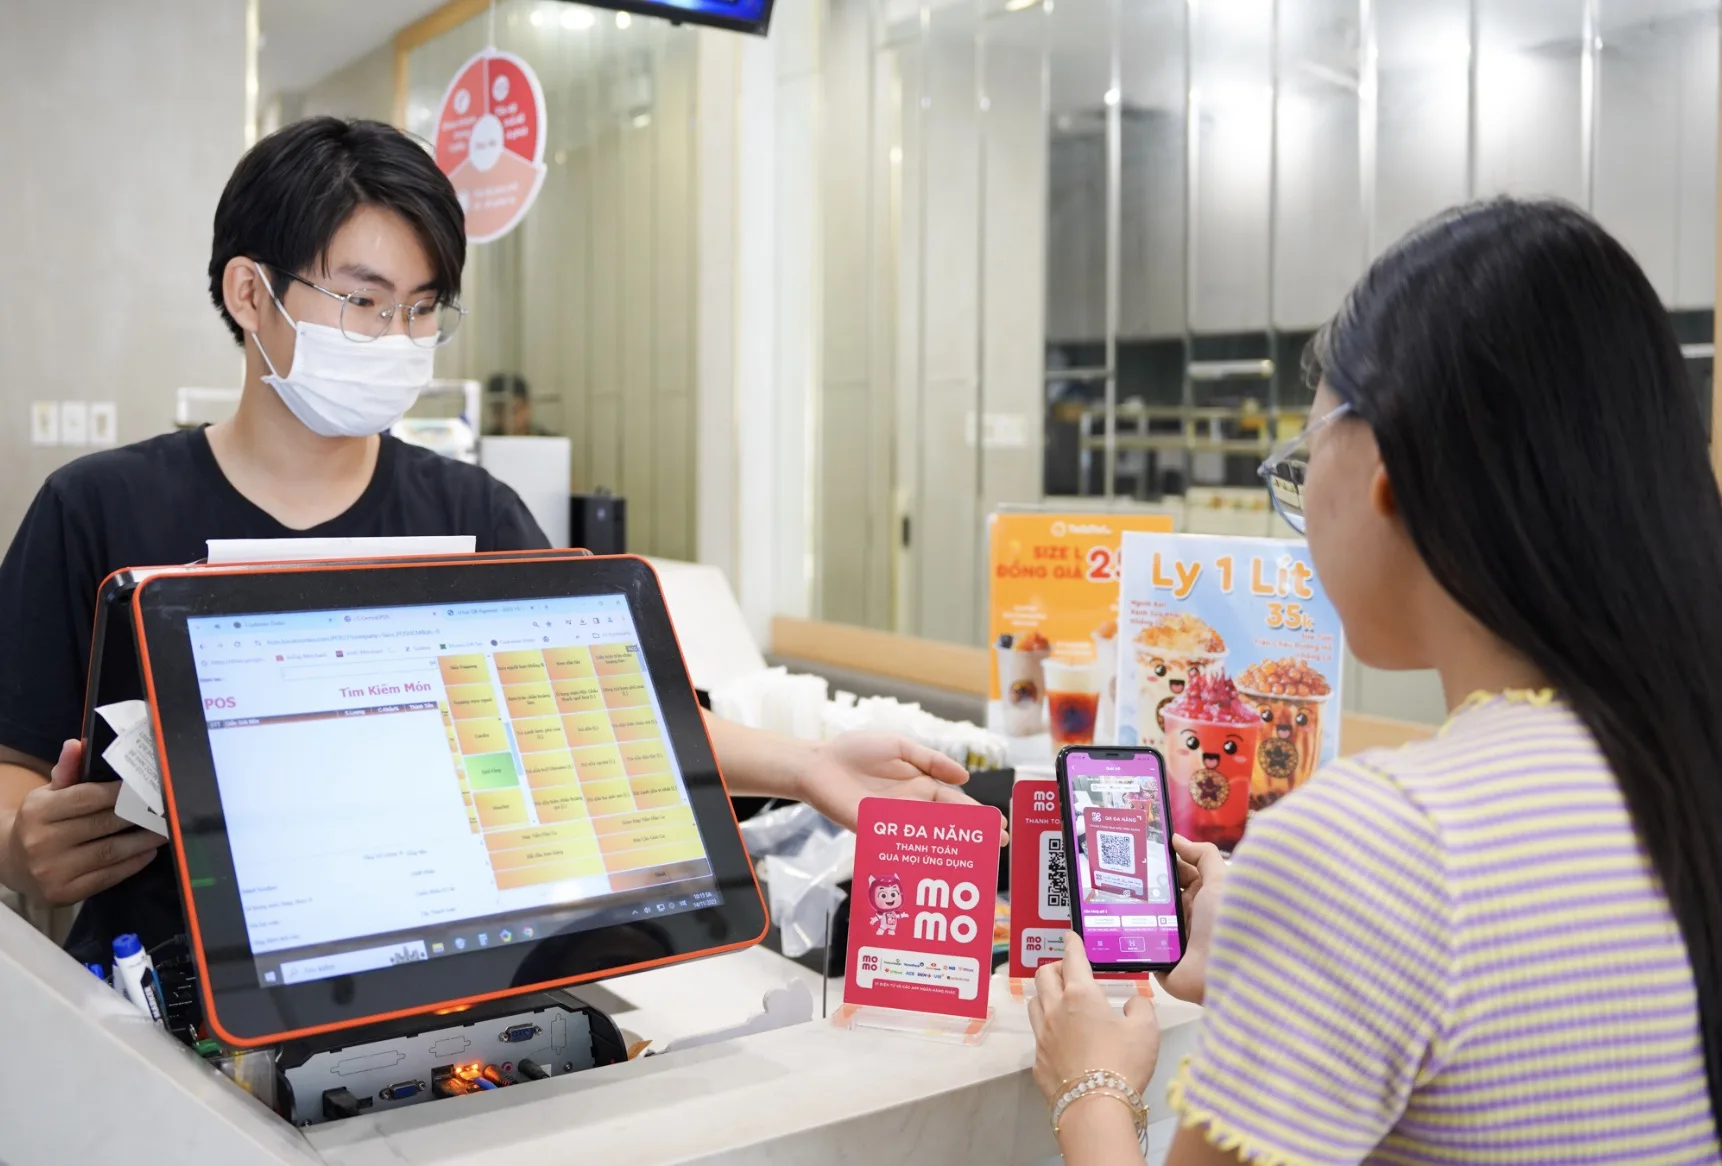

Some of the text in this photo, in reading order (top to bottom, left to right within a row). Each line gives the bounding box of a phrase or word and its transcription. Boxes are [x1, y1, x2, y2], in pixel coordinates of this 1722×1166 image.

[1033, 545, 1068, 560] SIZE
[1152, 552, 1313, 599] Ly 1 Lít
[204, 697, 236, 710] POS
[1025, 817, 1049, 825] THANH
[873, 821, 984, 843] QR ĐA NĂNG
[895, 842, 959, 856] THANH TOÁN
[878, 852, 974, 870] QUA MỌI ỨNG DỤNG
